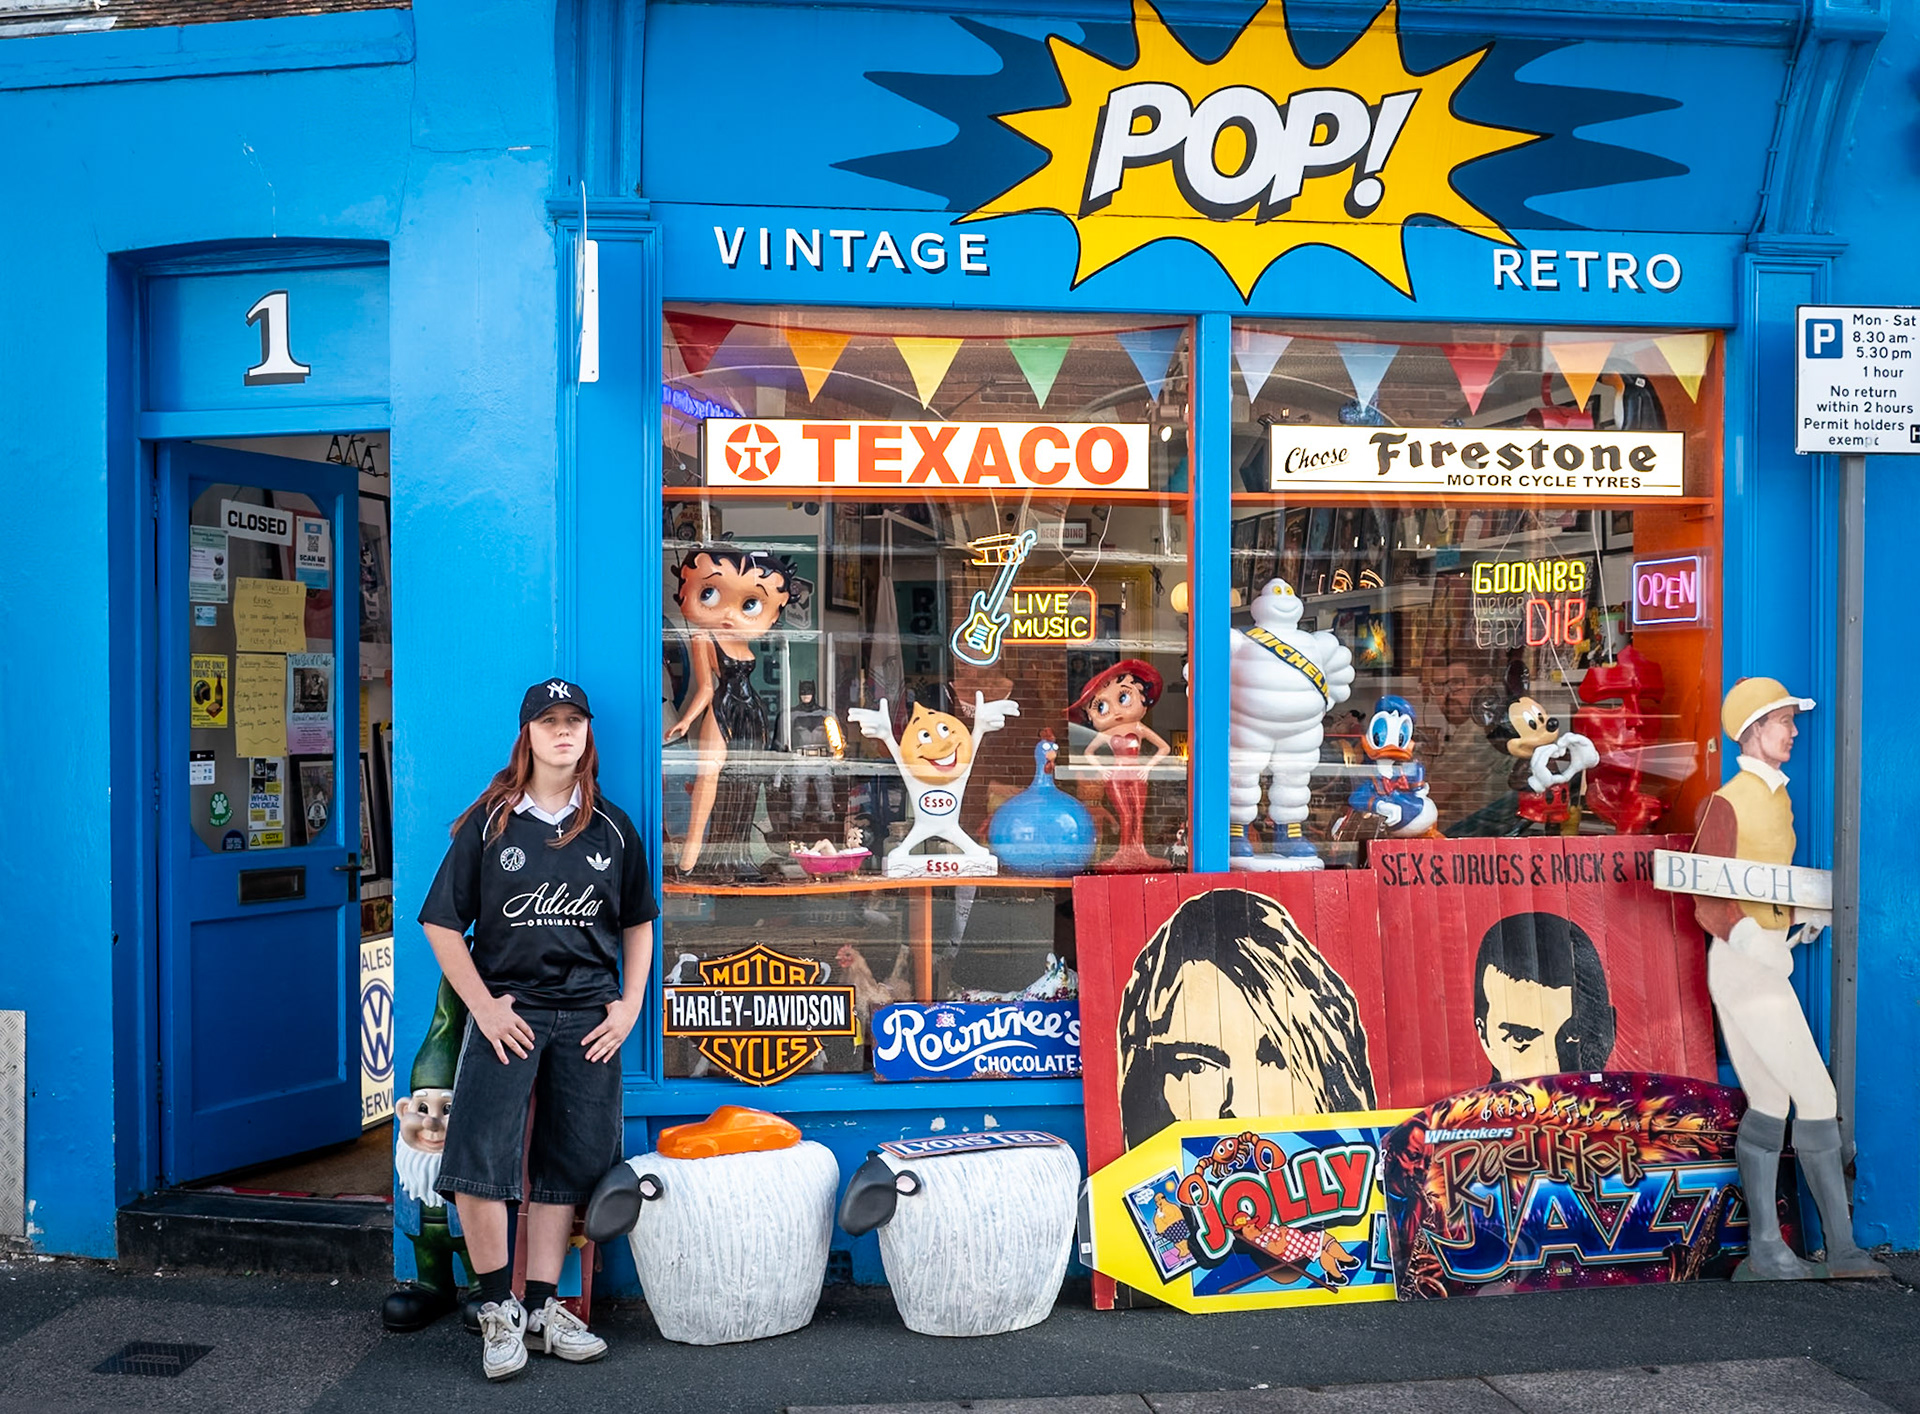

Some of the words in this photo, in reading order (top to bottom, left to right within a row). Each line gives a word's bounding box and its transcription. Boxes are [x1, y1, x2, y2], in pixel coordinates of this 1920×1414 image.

[1082, 82, 1422, 218] POP!
[713, 226, 990, 276] VINTAGE
[1493, 249, 1683, 292] RETRO
[1853, 314, 1881, 326] Mon
[1893, 314, 1917, 327] Sat
[246, 290, 310, 385] 1
[1813, 323, 1836, 355] P
[1852, 331, 1885, 344] 8.30
[1889, 334, 1908, 343] am
[1856, 347, 1888, 359] 5.30
[1892, 350, 1912, 361] pm
[1863, 366, 1868, 378] 1
[1873, 366, 1904, 378] hour
[1816, 401, 1859, 413] within
[1863, 402, 1872, 413] 2
[1875, 402, 1914, 414] hours
[1830, 385, 1850, 397] No
[1854, 386, 1897, 398] return
[1803, 418, 1849, 430] Permit
[1854, 418, 1905, 431] holders
[802, 425, 1129, 485] TEXACO
[1284, 446, 1350, 475] Choose
[1369, 433, 1658, 476] Firestone
[1447, 475, 1512, 488] MOTOR
[1519, 476, 1577, 489] CYCLE
[1583, 477, 1641, 490] TYRES
[228, 510, 287, 536] CLOSED
[1013, 593, 1069, 615] LIVE
[1638, 570, 1697, 610] OPEN
[1013, 617, 1088, 638] MUSIC
[249, 801, 261, 809] ON
[261, 801, 280, 809] DEAL
[251, 794, 280, 802] WHAT'S
[1381, 852, 1424, 887] SEX
[1430, 854, 1445, 886] &
[1452, 853, 1525, 886] DRUGS
[1530, 853, 1547, 886] &
[1551, 853, 1606, 885] ROCK
[1612, 852, 1627, 883] &
[1666, 856, 1796, 904] BEACH
[502, 881, 603, 918] Adidas
[527, 918, 585, 928] ORIGINALS
[713, 952, 806, 985] MOTOR
[672, 994, 846, 1027] HARLEY-DAVIDSON
[877, 1007, 1080, 1072] Rowntree's
[713, 1037, 808, 1079] CYCLES
[986, 1132, 1051, 1144] TEA
[1424, 1127, 1513, 1144] Whittakers
[1435, 1124, 1540, 1219] Red
[1541, 1124, 1644, 1193] Hot
[1194, 1151, 1369, 1252] JOLLY
